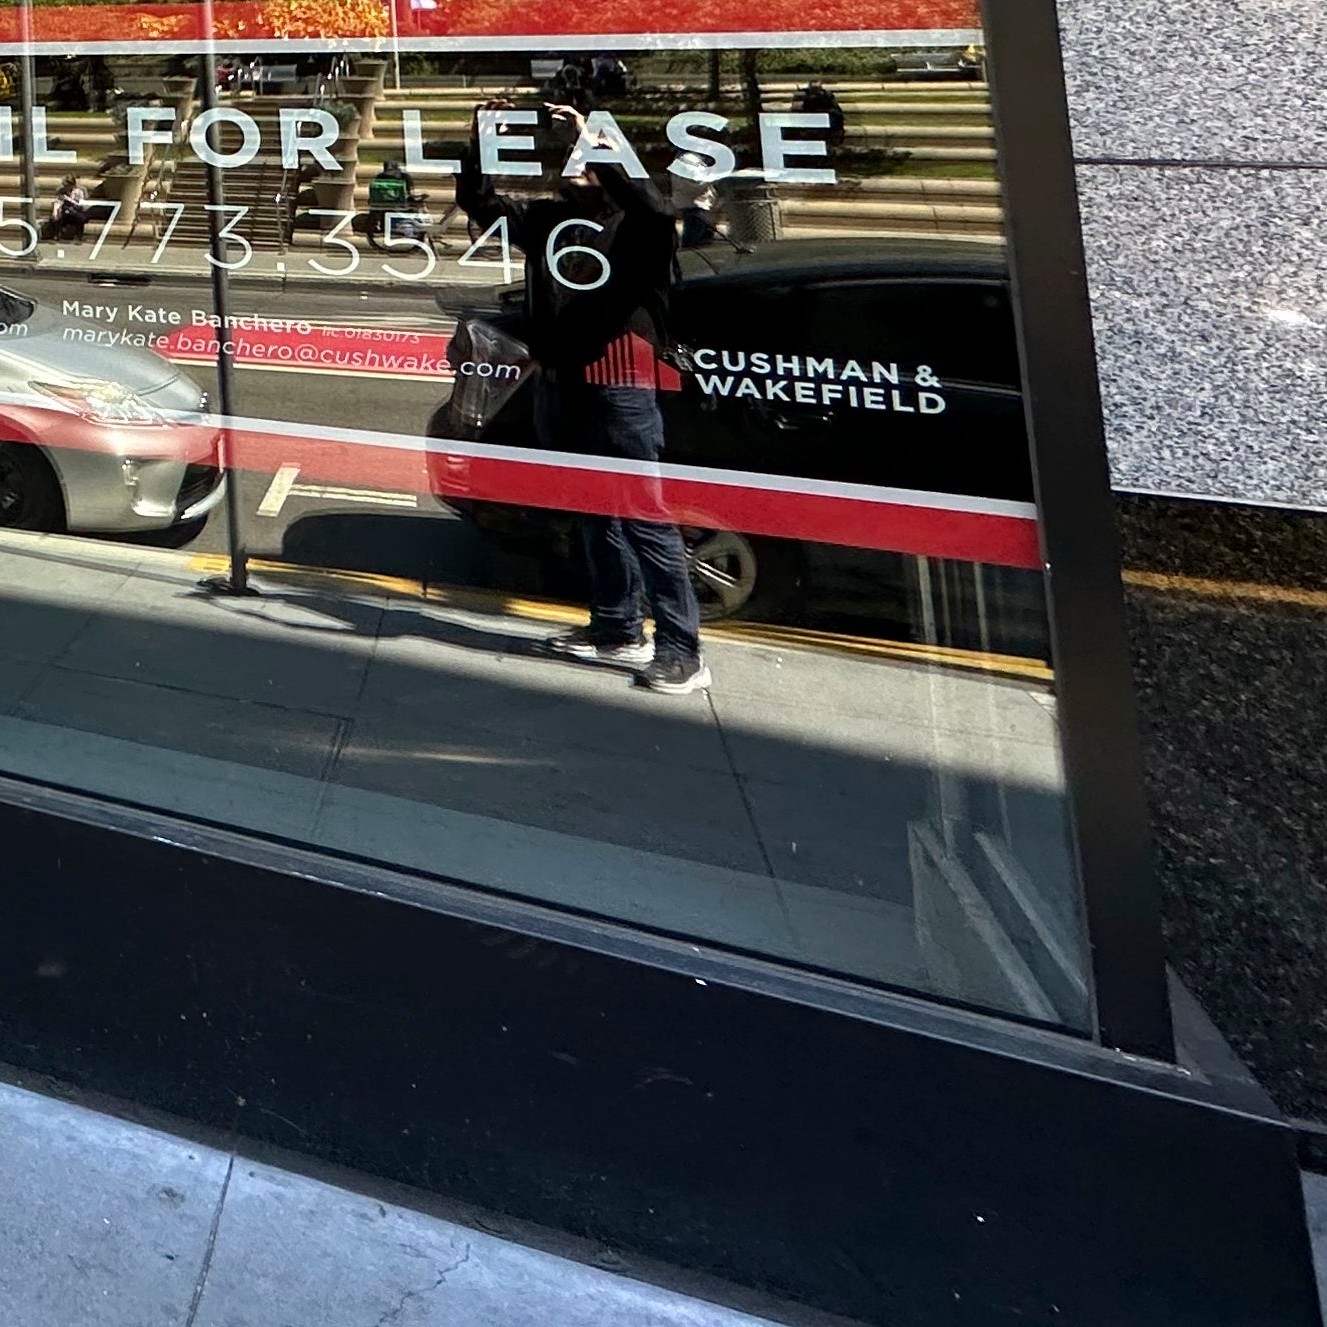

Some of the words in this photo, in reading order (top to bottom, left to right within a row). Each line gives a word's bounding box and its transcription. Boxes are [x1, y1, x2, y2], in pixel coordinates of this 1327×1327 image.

[126, 107, 343, 170] FOR
[402, 109, 838, 185] LEASE
[61, 300, 118, 322] Mary
[128, 304, 182, 325] Kate
[191, 309, 313, 335] Banchero
[62, 326, 522, 381] marykate.banchero@cushwake.com
[692, 347, 899, 386] CUSHMAN
[912, 364, 942, 389] &
[694, 373, 947, 416] WAKEFIELD
